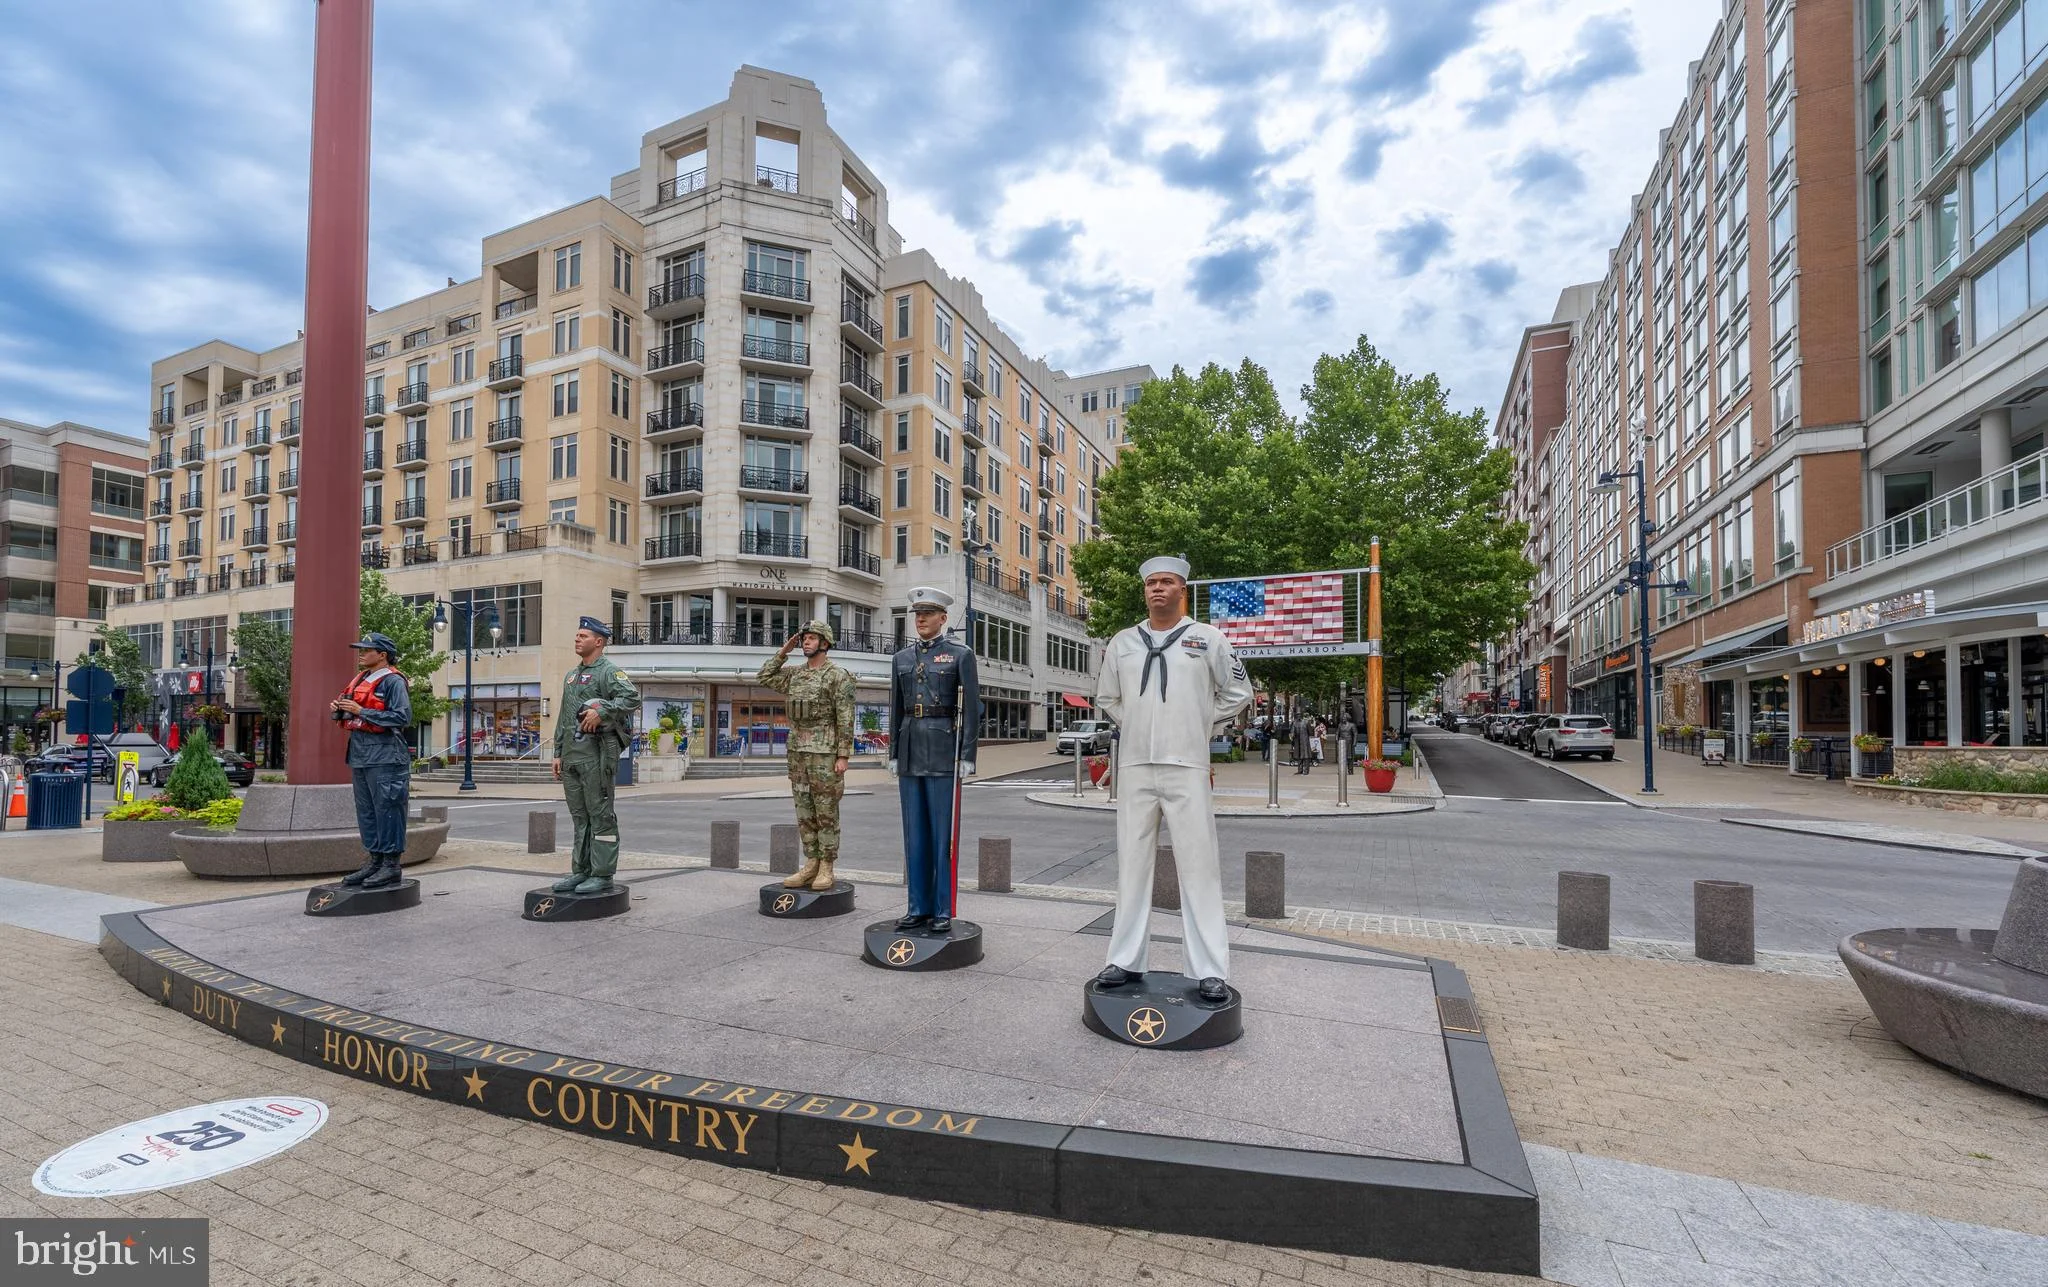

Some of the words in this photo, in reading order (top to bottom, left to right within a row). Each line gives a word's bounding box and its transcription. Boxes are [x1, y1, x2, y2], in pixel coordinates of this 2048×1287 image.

[732, 582, 776, 591] NATIONAL
[760, 565, 787, 582] ONE
[1235, 648, 1272, 656] IONAL
[1289, 646, 1337, 655] HARBOR
[193, 985, 242, 1030] DUTY
[300, 1004, 537, 1066] PROTECTING
[542, 1057, 673, 1091] YOUR
[689, 1079, 982, 1136] FREEDOM
[323, 1028, 432, 1092] HONOR
[526, 1077, 759, 1155] COUNTRY
[155, 1120, 247, 1152] 250
